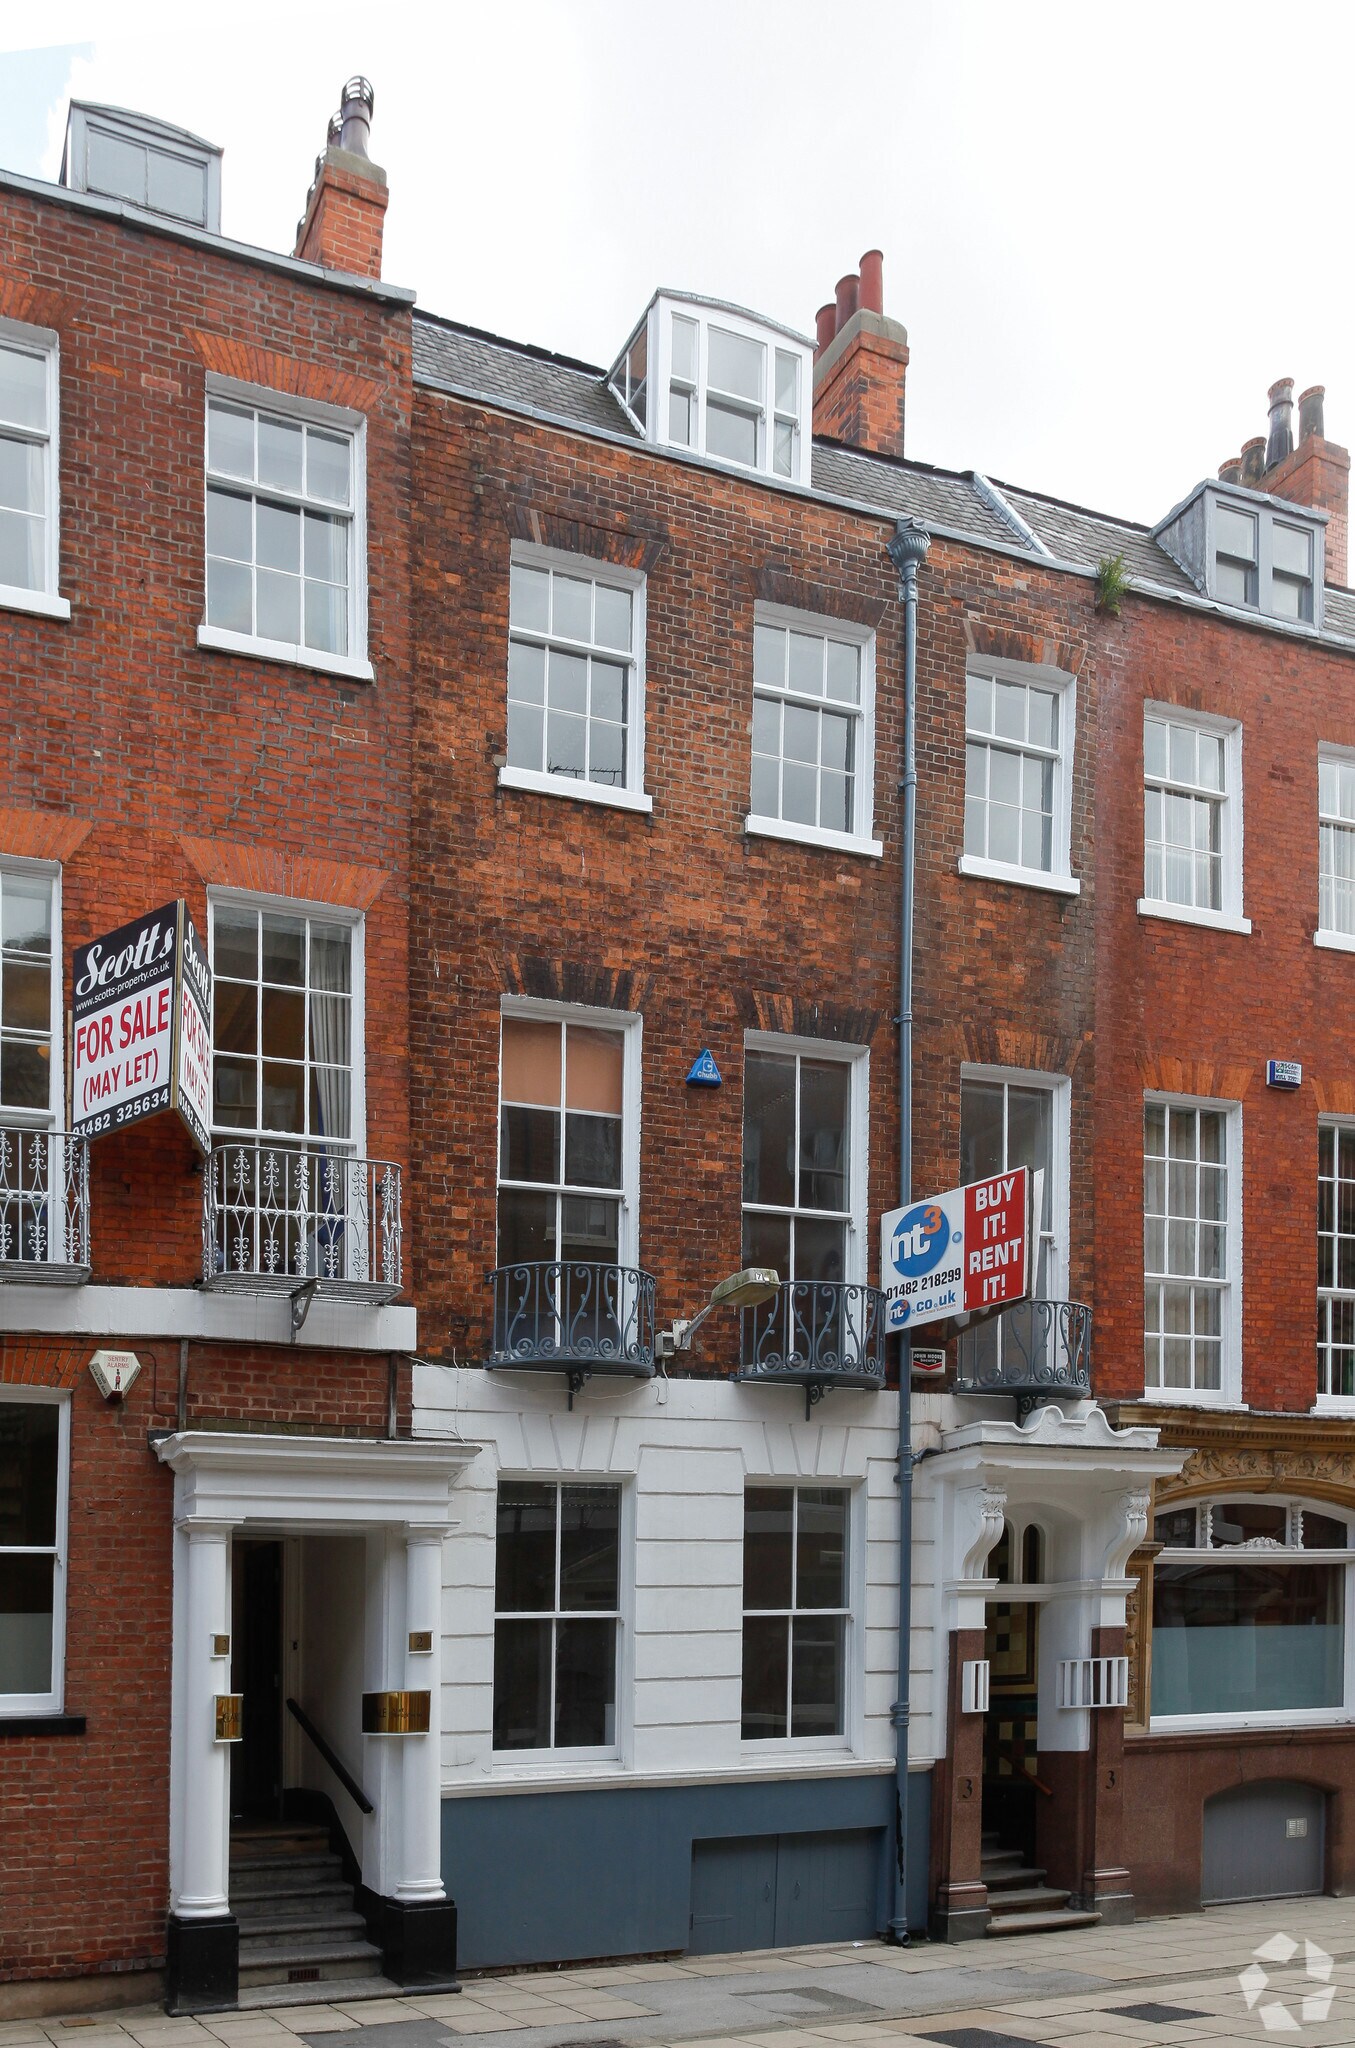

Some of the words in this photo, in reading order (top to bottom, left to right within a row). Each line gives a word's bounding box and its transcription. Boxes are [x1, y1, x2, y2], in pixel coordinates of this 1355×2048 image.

[76, 922, 174, 996] Scotts
[75, 960, 170, 1012] www.scotts-property.co.uk
[77, 1014, 113, 1070] FOR
[119, 987, 170, 1050] SALE
[182, 990, 197, 1053] FOR
[197, 1021, 209, 1083] SALE
[83, 1064, 122, 1112] (MAY
[125, 1047, 159, 1088] LET)
[697, 1070, 718, 1080] Chubb
[116, 1088, 169, 1123] 325634
[975, 1177, 1016, 1212] BUY
[983, 1211, 1006, 1240] IT!
[969, 1238, 1022, 1275] RENT
[887, 1280, 918, 1301] 01482
[921, 1267, 962, 1291] 218299
[983, 1273, 1006, 1302] IT!
[416, 1636, 423, 1647] 2
[962, 1778, 973, 1799] 3
[1105, 1769, 1115, 1790] 3
